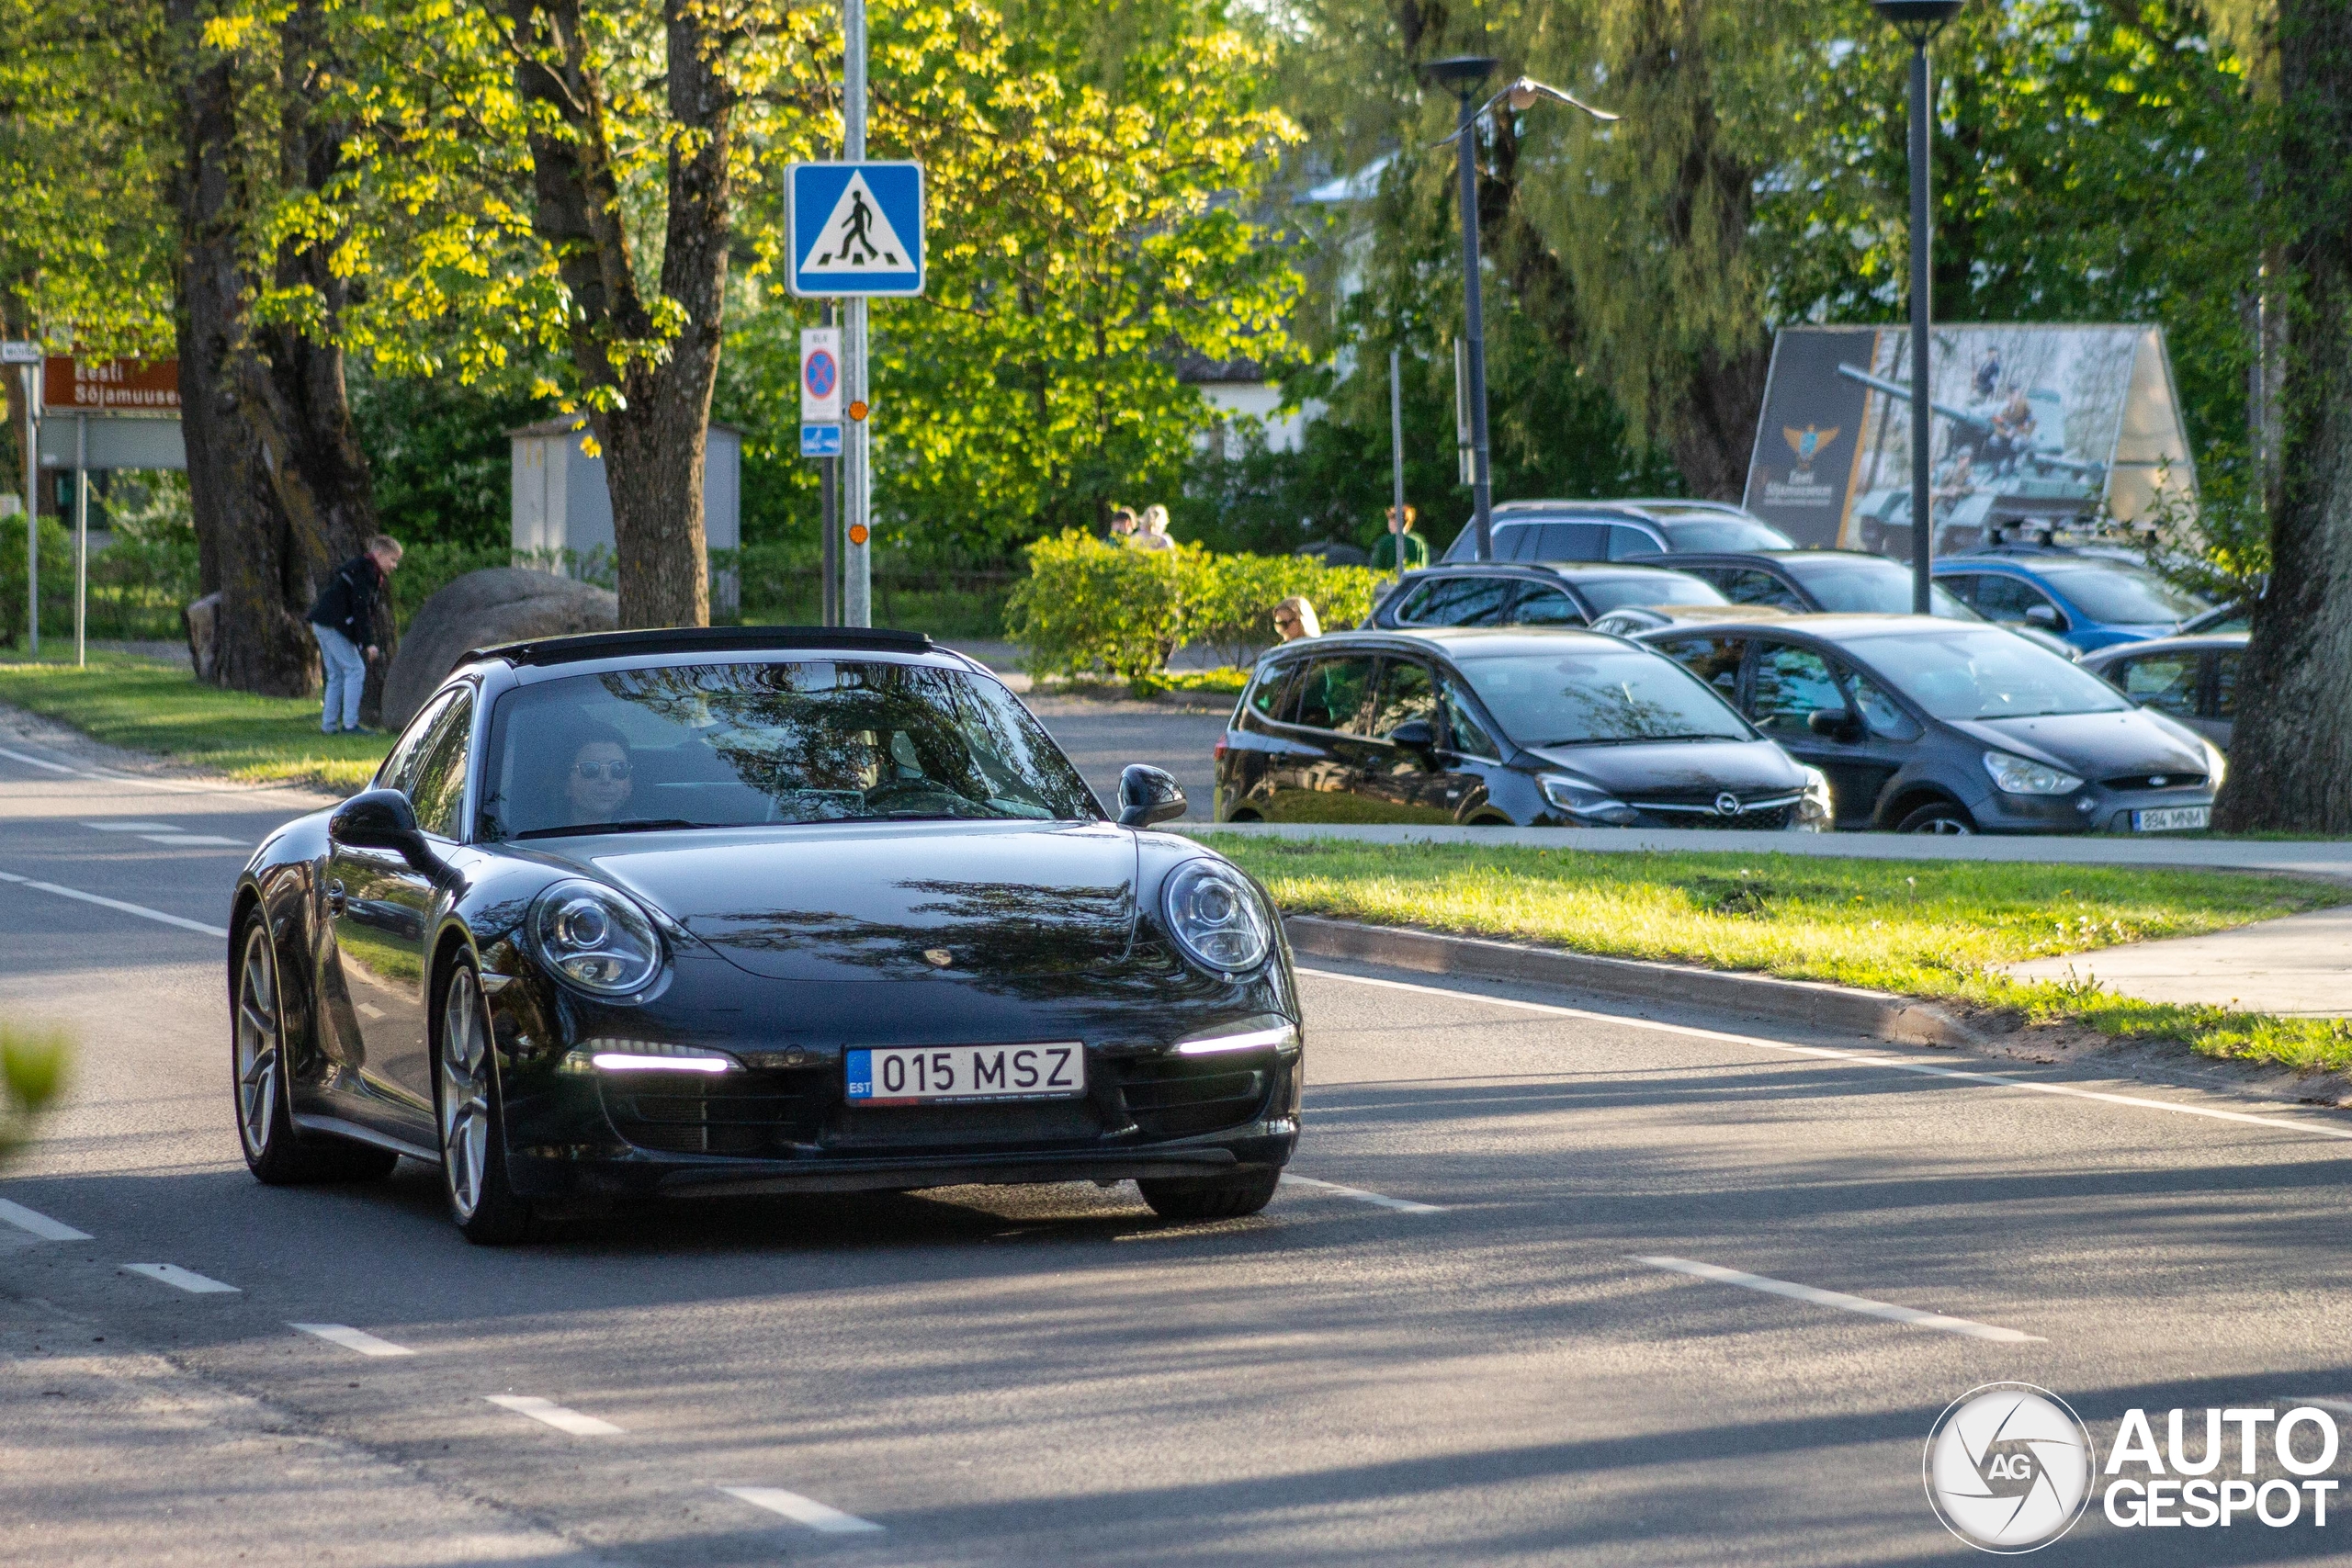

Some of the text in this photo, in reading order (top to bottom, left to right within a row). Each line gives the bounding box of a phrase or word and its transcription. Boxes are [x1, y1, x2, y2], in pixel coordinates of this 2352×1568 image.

[883, 1048, 1073, 1091] 015 MSZ
[849, 1082, 872, 1093] EST
